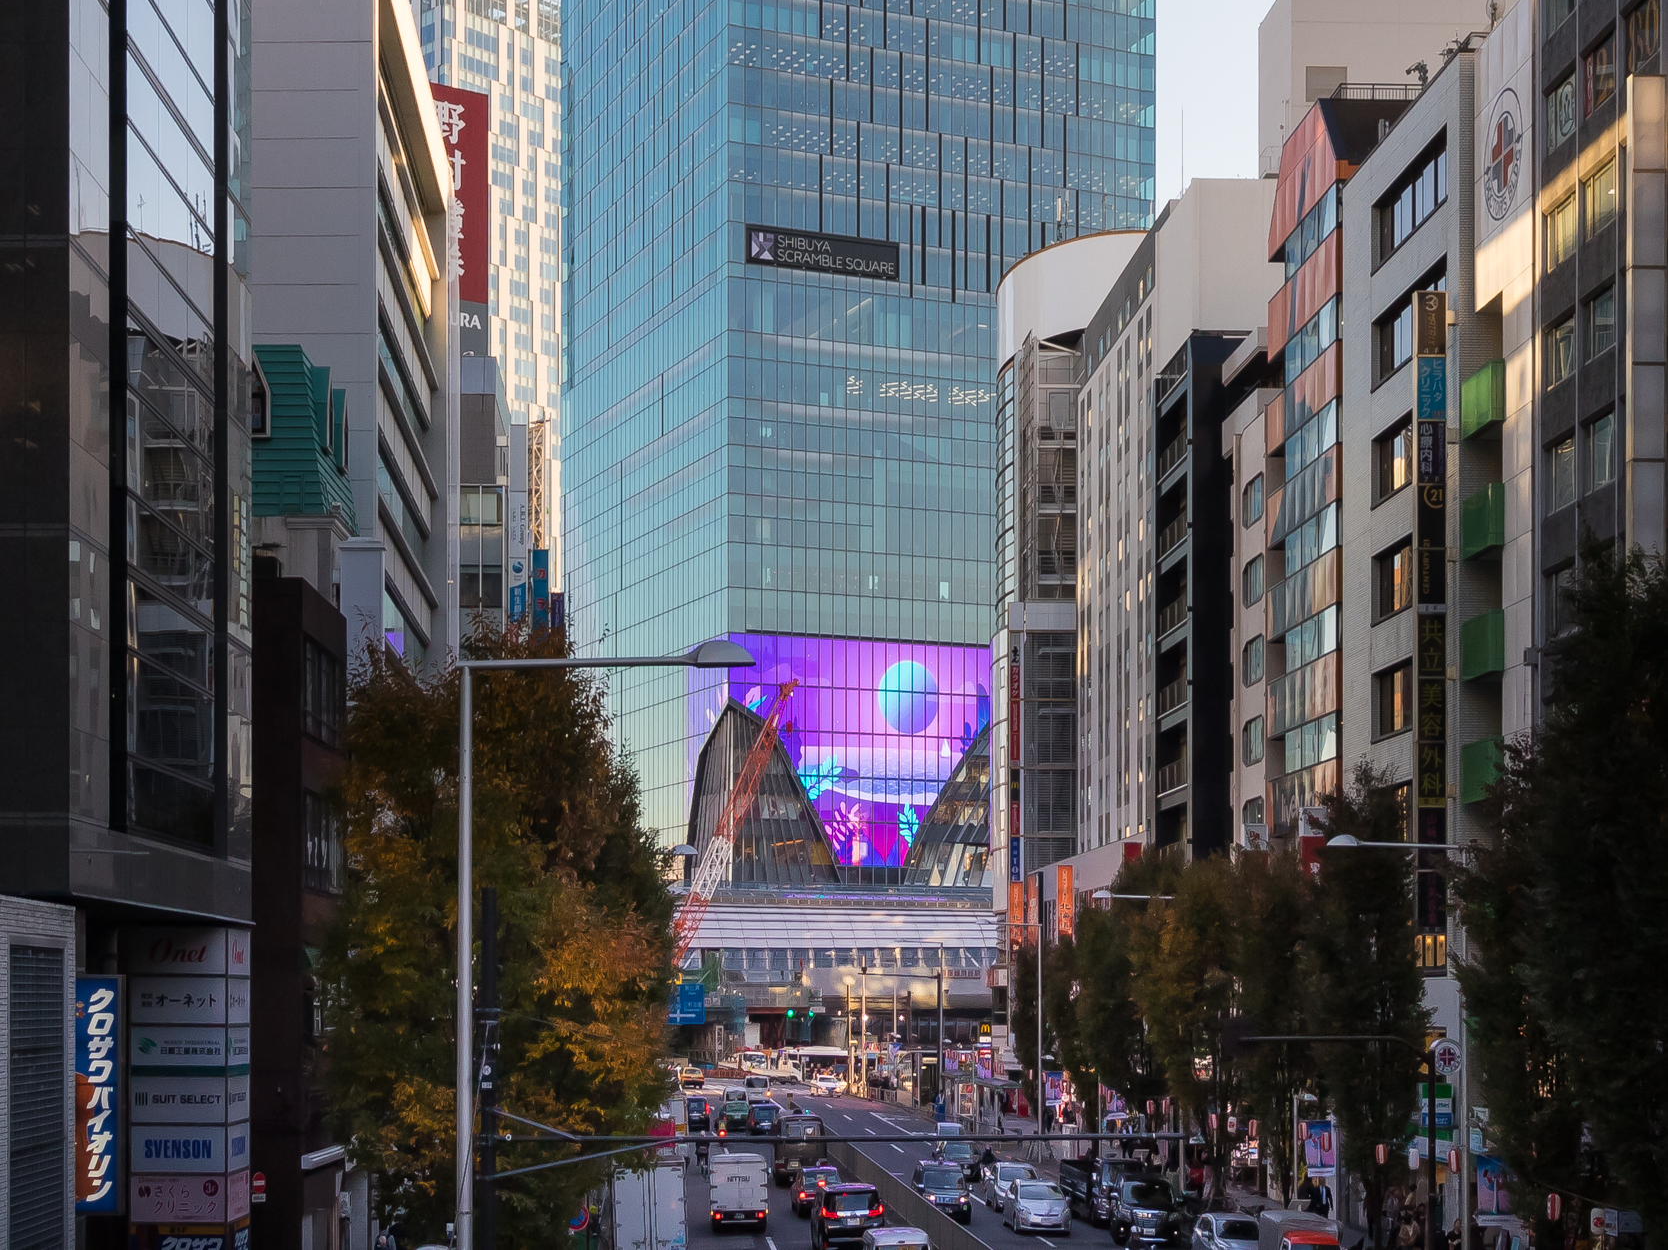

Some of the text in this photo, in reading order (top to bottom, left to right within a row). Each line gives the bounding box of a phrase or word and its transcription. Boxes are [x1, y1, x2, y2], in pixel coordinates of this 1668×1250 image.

[777, 234, 832, 253] SHIBUYA
[777, 249, 895, 275] SCRAMBLE SQUARE
[1420, 422, 1433, 474] 心療内科
[1422, 539, 1430, 595] CENTURY 21
[1011, 666, 1019, 697] カラオケ
[1420, 619, 1443, 795] 共立美容外科
[155, 993, 217, 1008] オーネット
[85, 987, 115, 1203] クロサワバイオリン
[152, 1094, 177, 1104] SUIT
[180, 1094, 221, 1104] SELECT
[144, 1139, 212, 1159] SVENSON
[727, 1175, 751, 1183] NITTSU
[154, 1184, 190, 1199] さくら
[154, 1200, 216, 1214] クリニック
